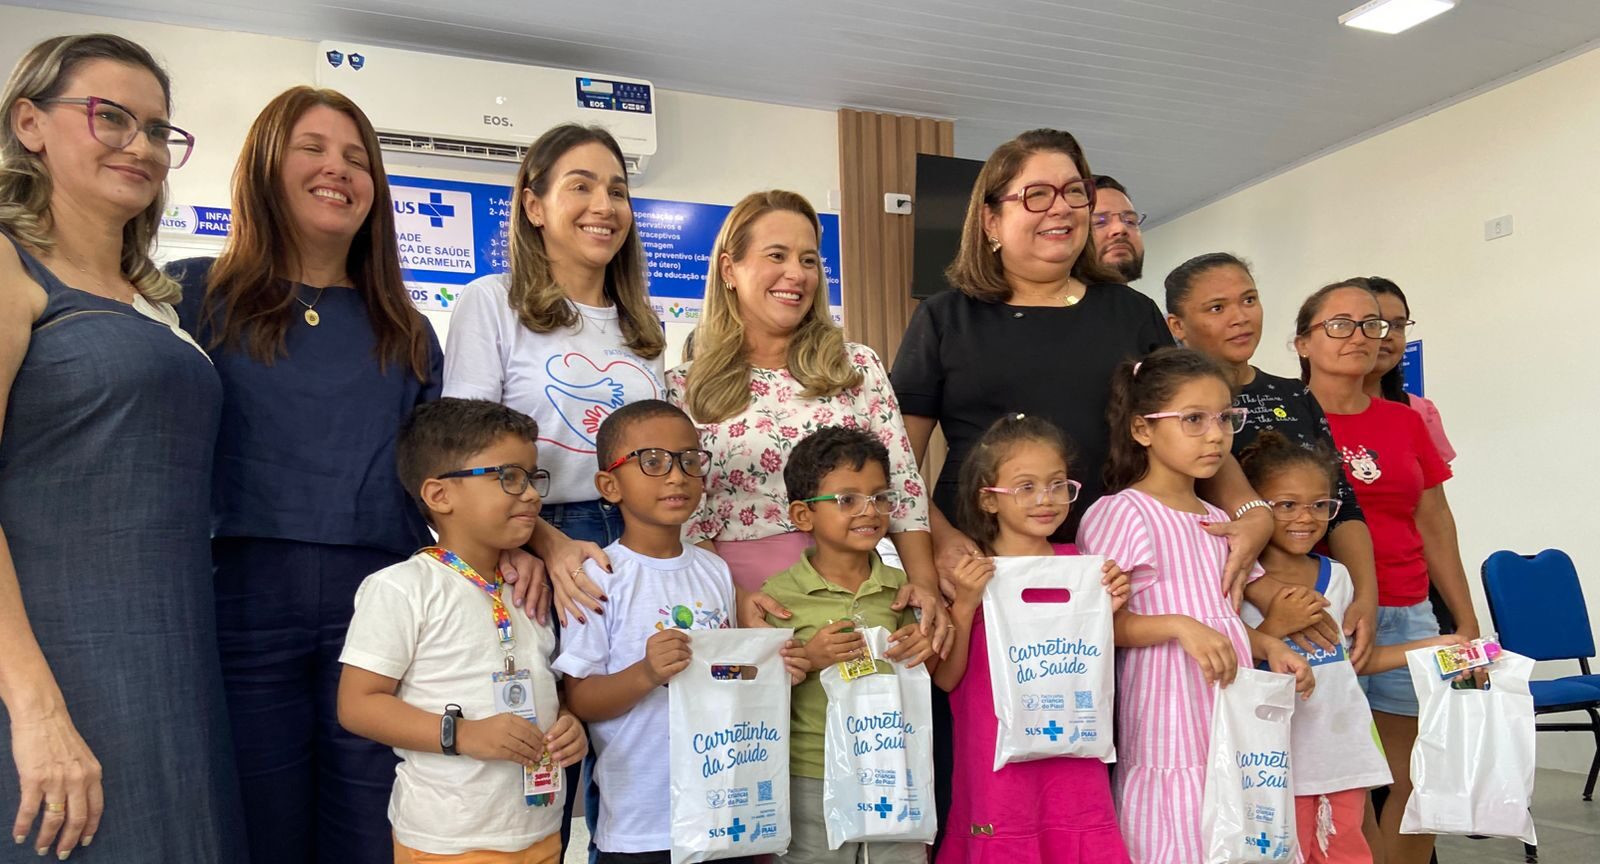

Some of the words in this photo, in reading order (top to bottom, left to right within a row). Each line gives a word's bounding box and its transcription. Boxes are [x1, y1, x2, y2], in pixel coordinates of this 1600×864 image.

[483, 115, 513, 127] EOS.
[417, 245, 431, 254] DE
[434, 246, 470, 257] SAÚDE
[654, 252, 693, 260] preventivo
[412, 256, 472, 269] CARMELITA
[659, 261, 681, 270] útero)
[664, 272, 699, 281] educação
[1009, 638, 1101, 663] Carretinha
[1017, 664, 1037, 684] da
[1040, 657, 1088, 678] Saúde
[1025, 727, 1041, 735] SUS
[693, 721, 781, 754] Carretinha
[854, 735, 872, 756] da
[702, 755, 724, 778] da
[727, 743, 769, 769] Saúde
[857, 803, 873, 811] SUS
[709, 828, 726, 838] SUS
